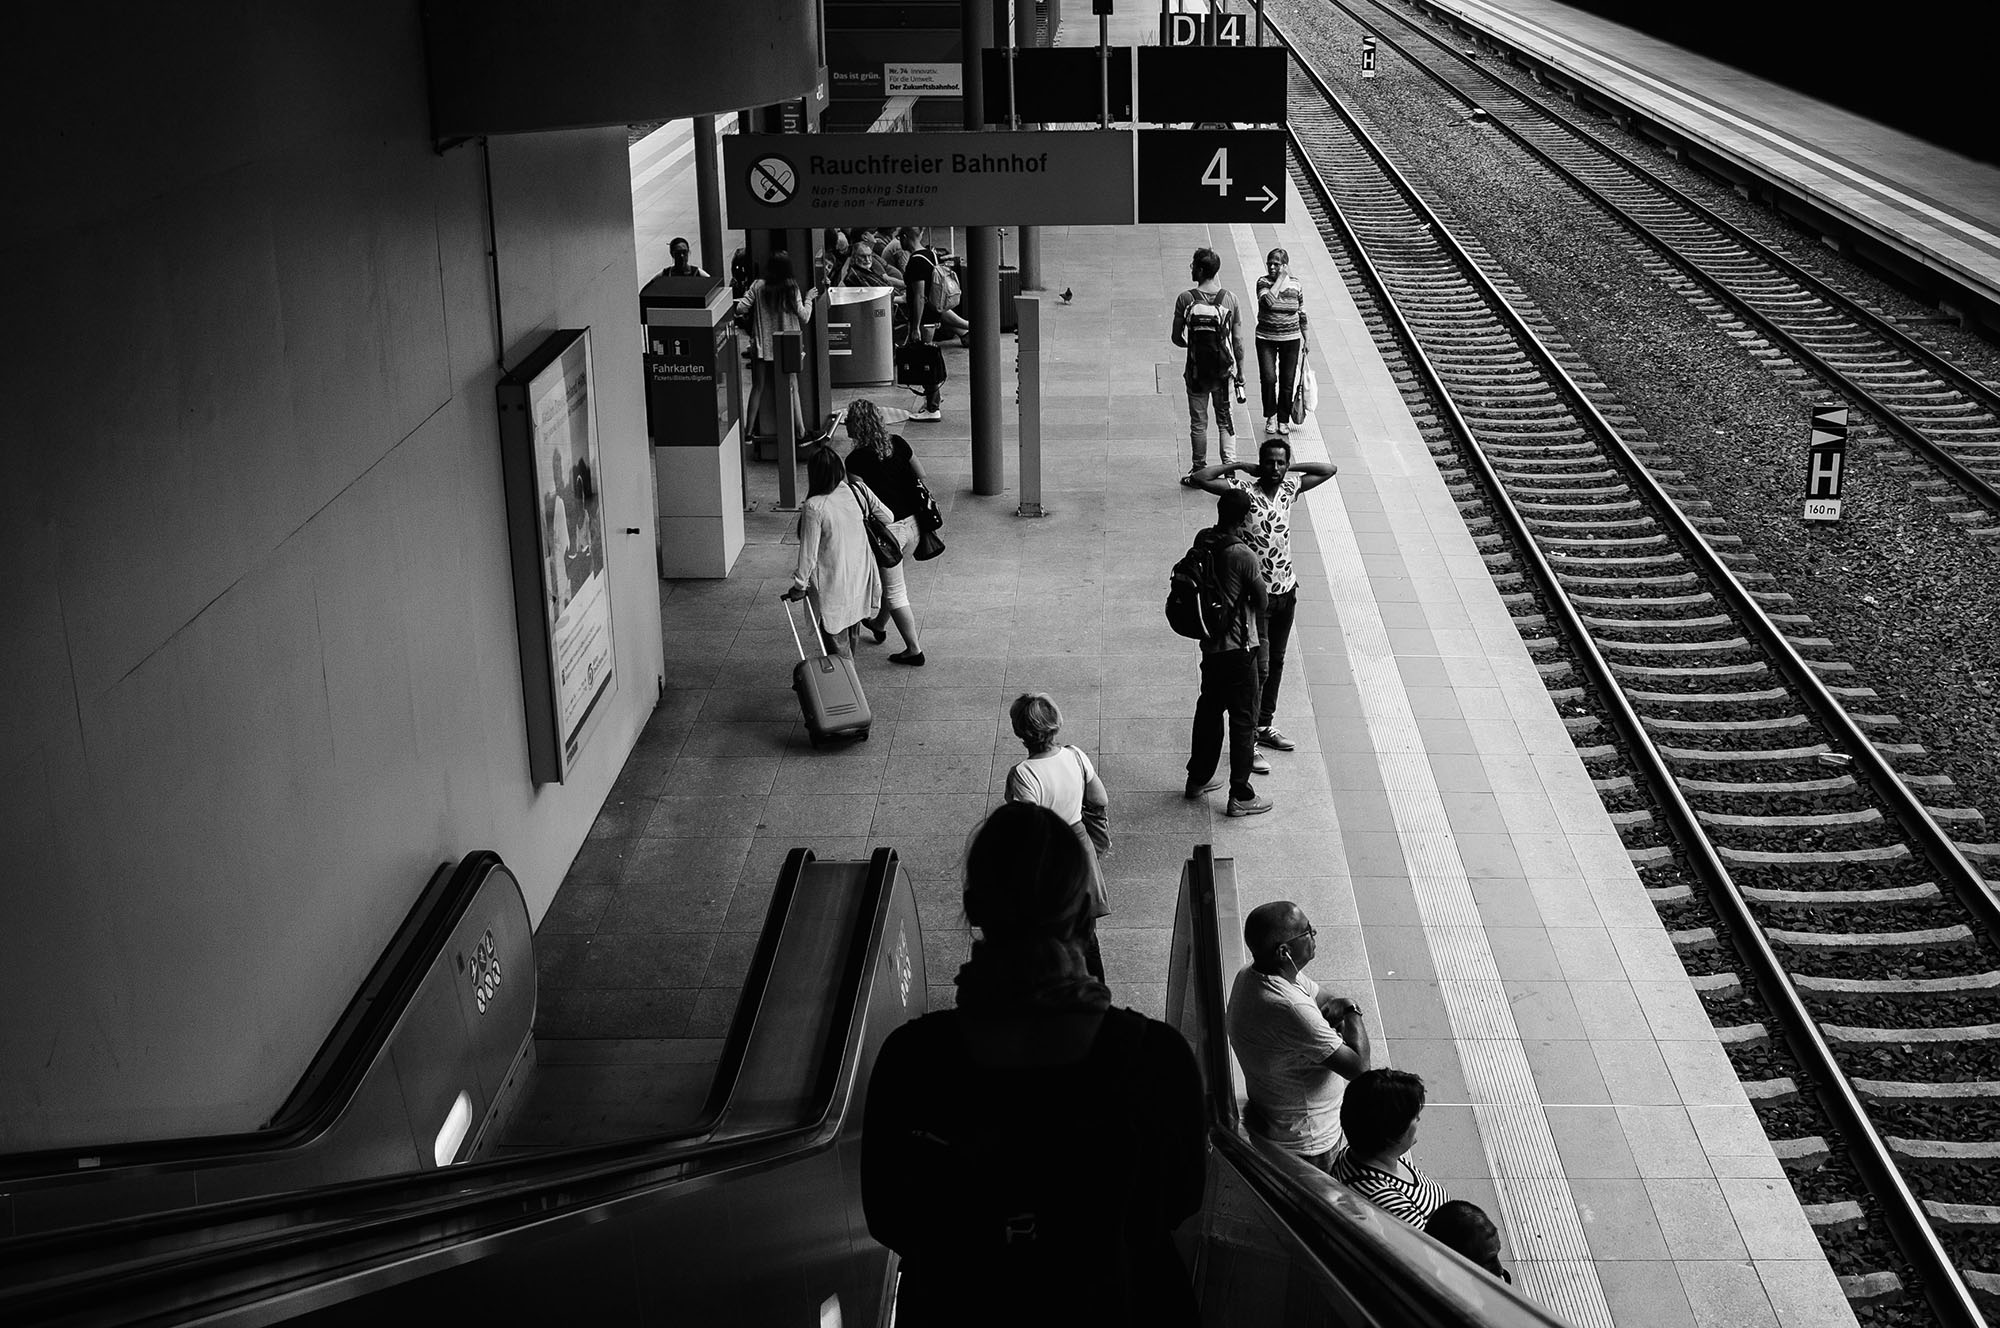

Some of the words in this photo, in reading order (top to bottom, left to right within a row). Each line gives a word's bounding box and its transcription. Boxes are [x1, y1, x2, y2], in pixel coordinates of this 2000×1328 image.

[1172, 15, 1196, 47] D
[1219, 15, 1241, 47] 4
[1363, 52, 1375, 69] H
[833, 71, 848, 80] Das
[849, 71, 860, 80] ist
[861, 71, 881, 83] grün.
[903, 83, 960, 91] Zukunftsbahnhof.
[809, 153, 943, 176] Rauchfreier
[952, 152, 1048, 174] Bahnhof
[1201, 147, 1233, 197] 4
[896, 183, 938, 194] Station
[811, 197, 842, 208] Gare
[652, 363, 705, 373] Fahrkarten
[1810, 453, 1841, 495] H
[1808, 504, 1826, 515] 160
[1826, 506, 1837, 515] m
